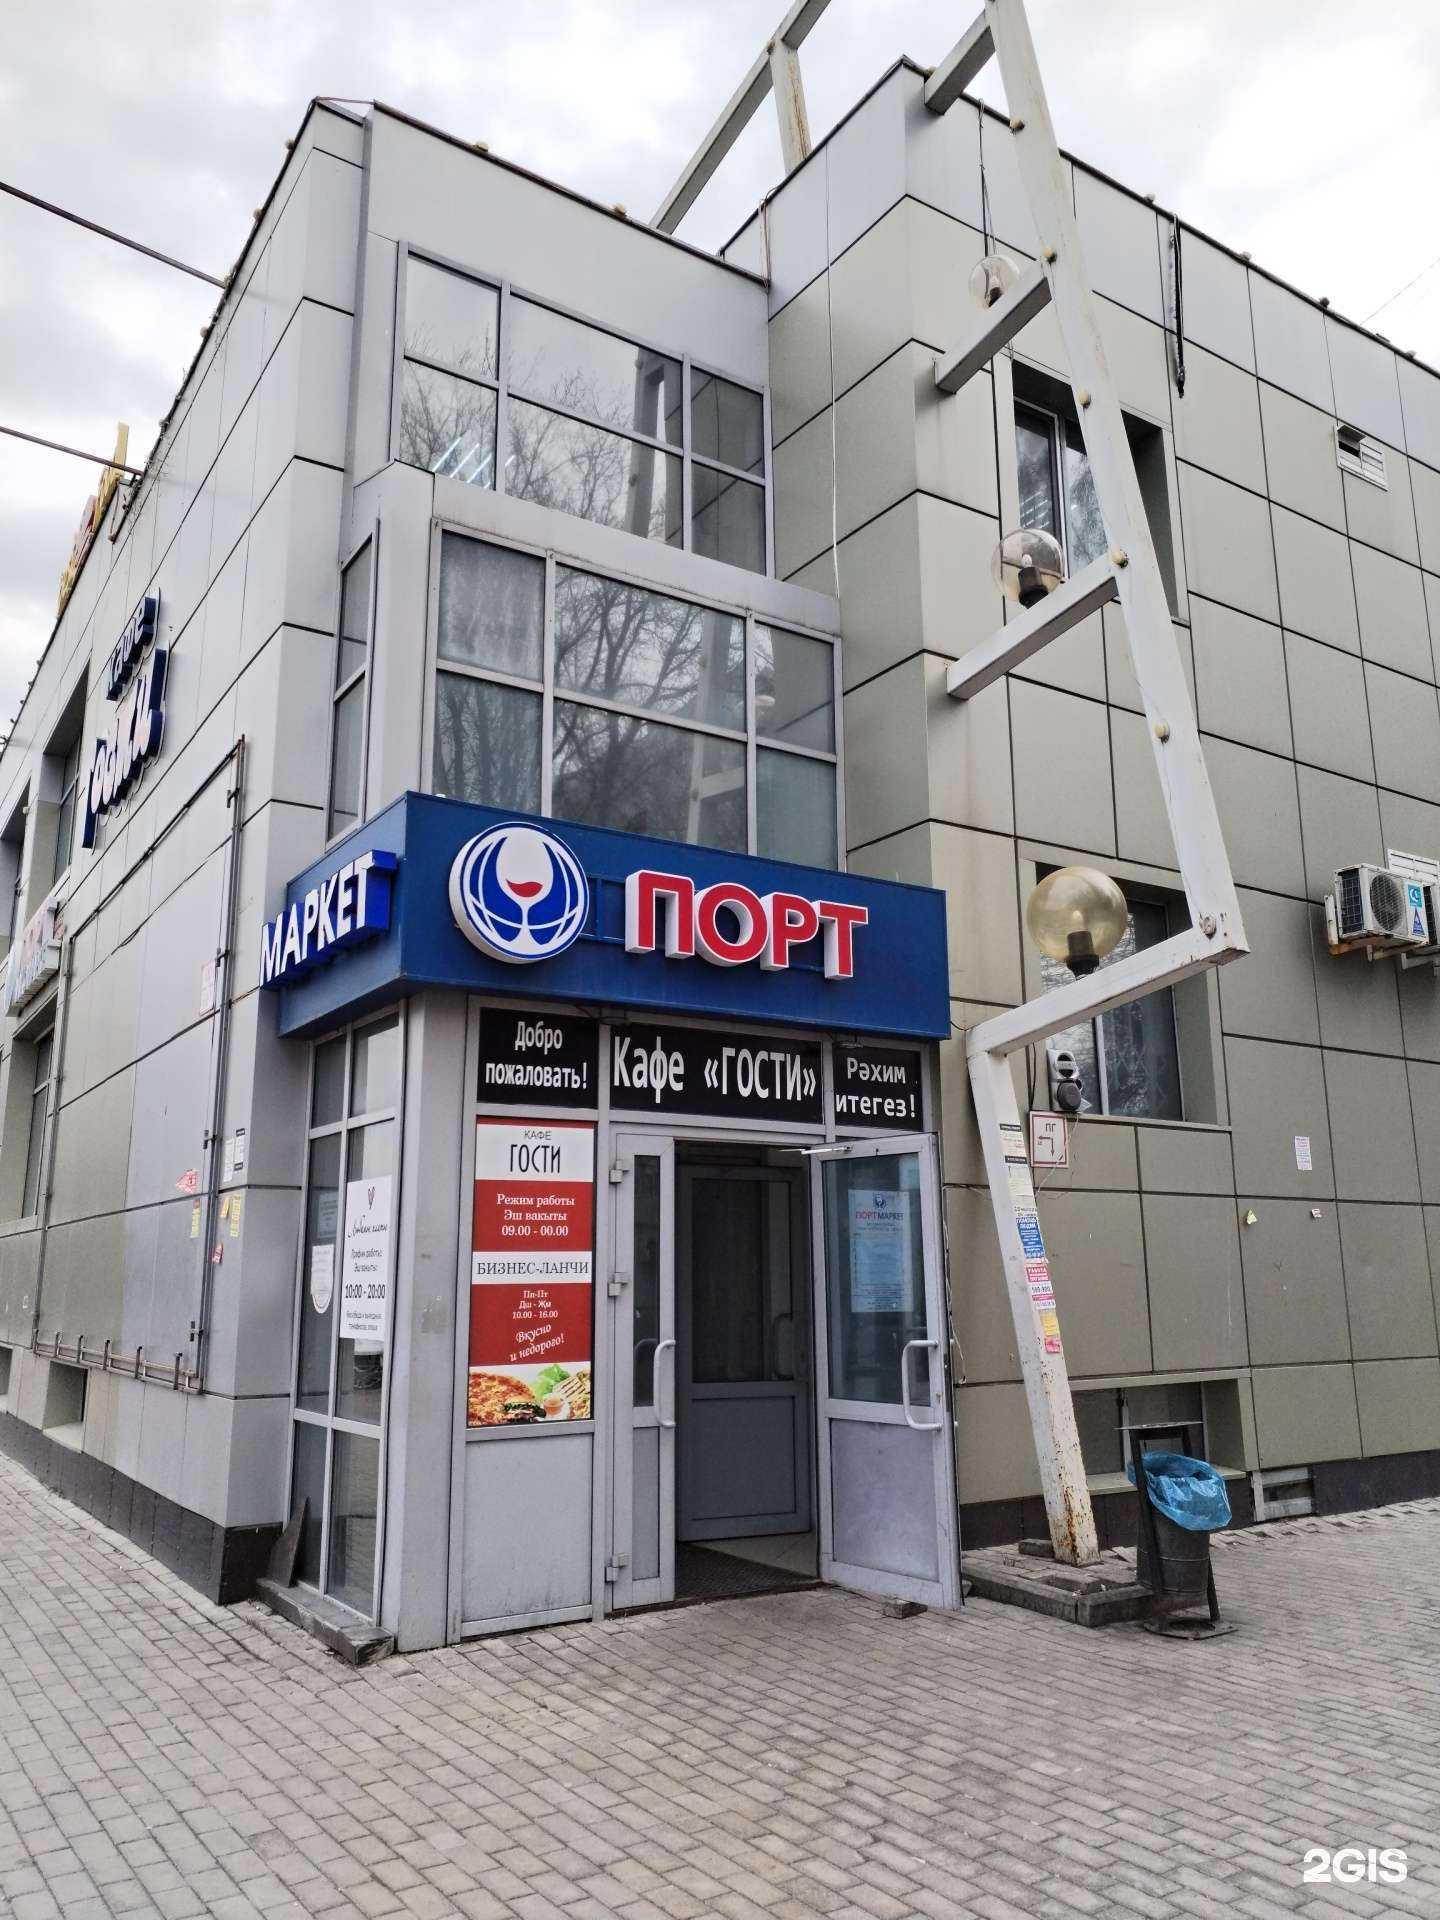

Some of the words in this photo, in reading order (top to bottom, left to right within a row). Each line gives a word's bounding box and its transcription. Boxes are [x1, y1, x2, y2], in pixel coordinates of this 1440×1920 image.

[260, 849, 393, 987] МАРКЕТ
[625, 869, 868, 980] ПОРТ
[515, 1021, 563, 1054] Добро
[485, 1062, 587, 1090] пожаловать!
[613, 1036, 685, 1104] Кафе
[704, 1046, 816, 1101] «ГОСТИ»
[847, 1057, 906, 1084] Рәхим
[835, 1094, 915, 1118] итегез!
[524, 1131, 552, 1141] КАФЕ
[510, 1144, 560, 1173] ГОСТИ
[496, 1194, 534, 1205] Режим
[536, 1195, 575, 1207] работы
[504, 1210, 522, 1220] Эш
[502, 1225, 531, 1236] 09.00
[540, 1225, 569, 1236] 00.00
[477, 1262, 589, 1275] БИЗНЕС-ЛАНЧИ
[345, 1284, 362, 1299] 10:00
[367, 1284, 386, 1299] 20:00
[512, 1311, 532, 1319] 10.00
[539, 1310, 559, 1318] 16.00
[516, 1324, 551, 1343] Вкусно
[519, 1332, 565, 1359] недорого!
